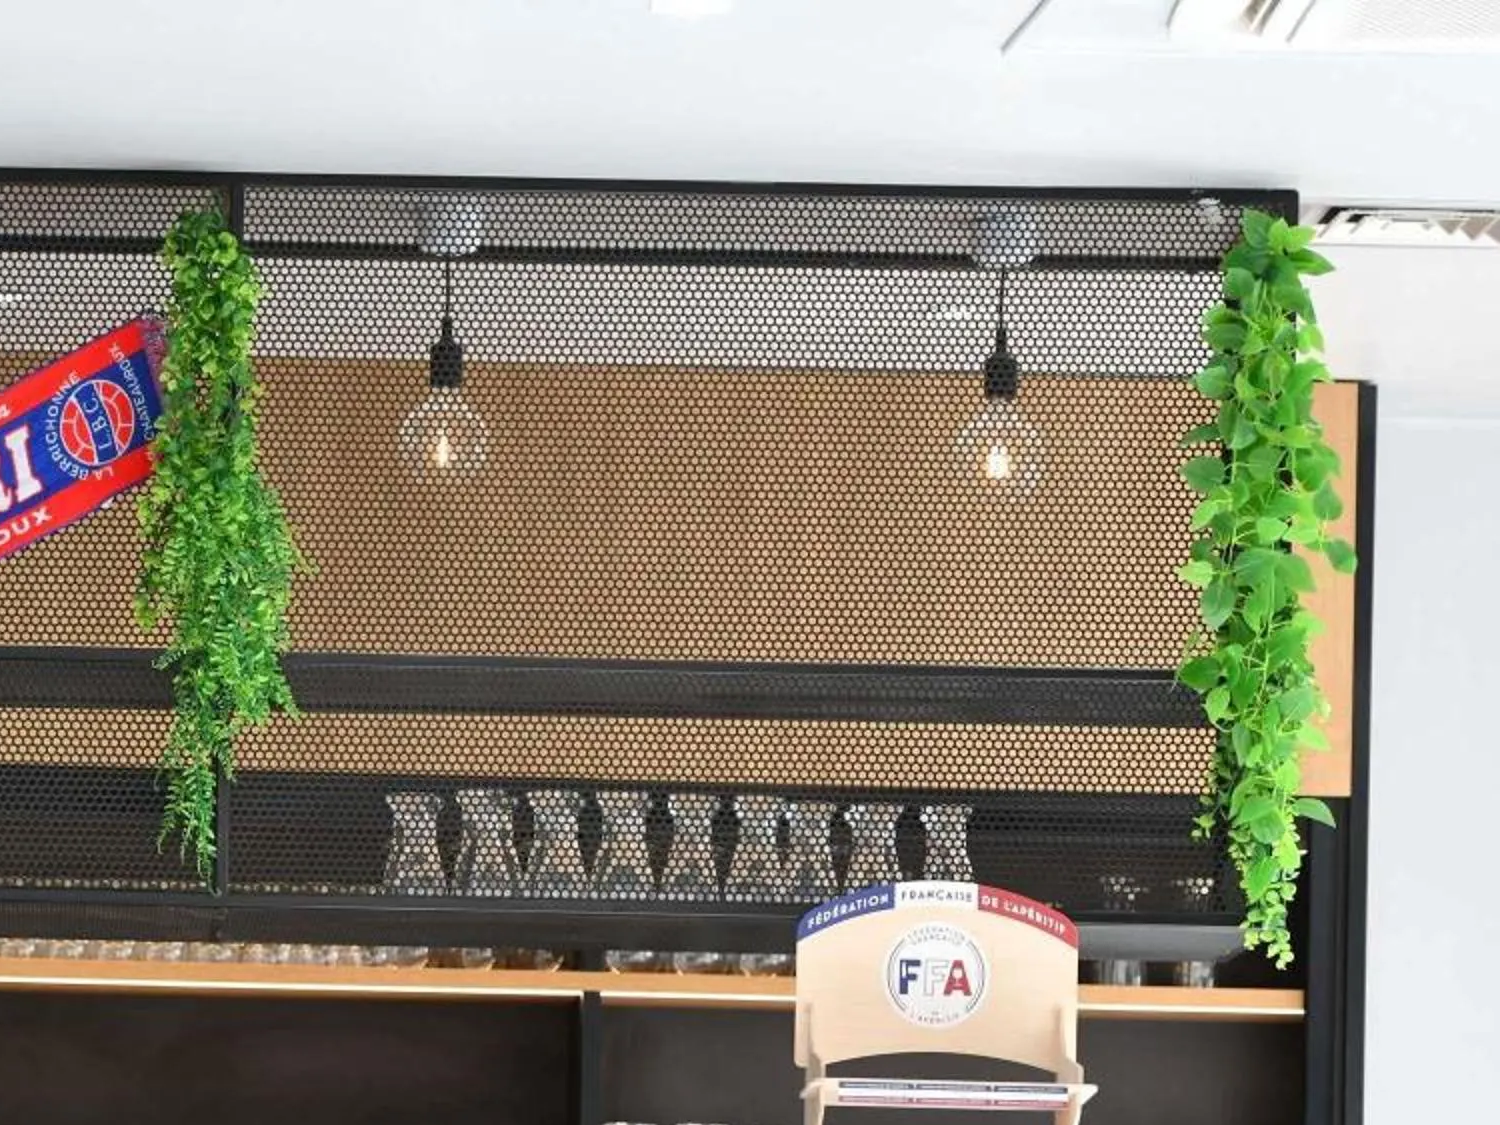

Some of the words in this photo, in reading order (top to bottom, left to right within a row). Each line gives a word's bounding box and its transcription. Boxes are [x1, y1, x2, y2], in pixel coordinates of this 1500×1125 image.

[45, 371, 89, 480] BERRICHONNE
[807, 893, 889, 929] FÉDÉRATION
[901, 890, 973, 903] FRANÇAISE
[981, 896, 998, 908] DE
[899, 959, 972, 996] FFA
